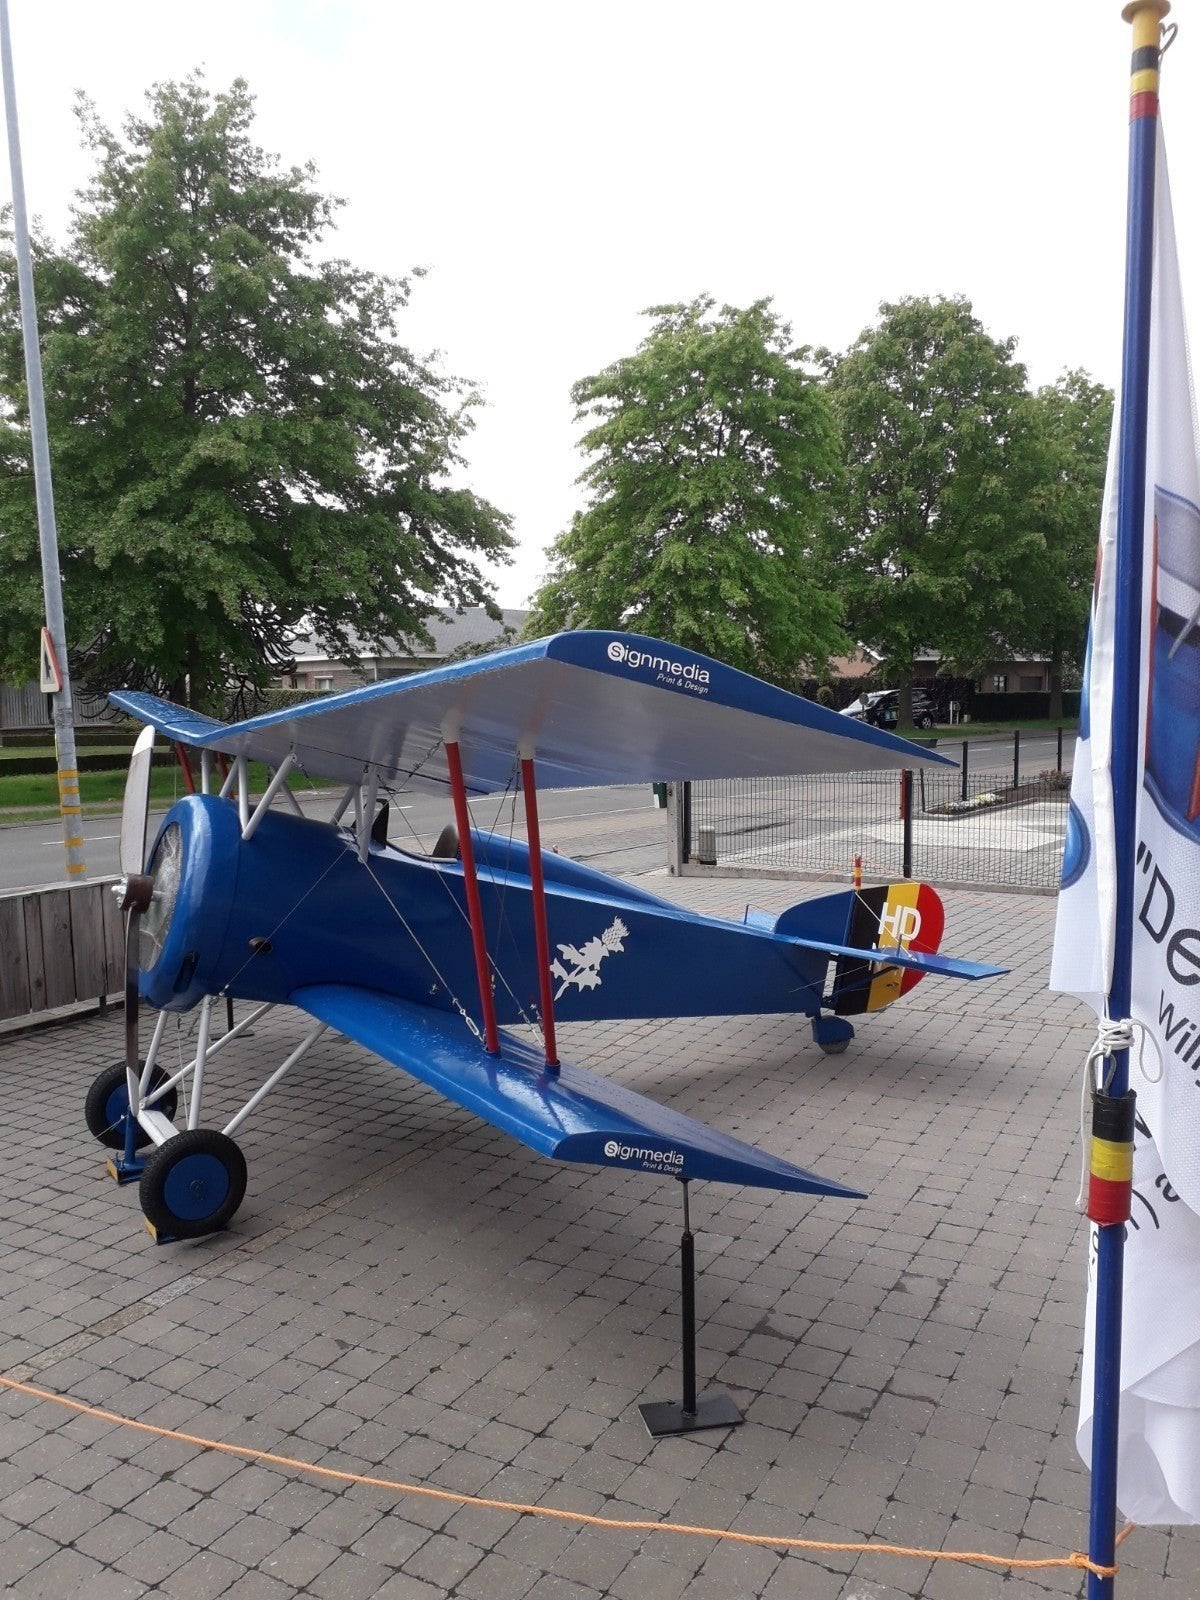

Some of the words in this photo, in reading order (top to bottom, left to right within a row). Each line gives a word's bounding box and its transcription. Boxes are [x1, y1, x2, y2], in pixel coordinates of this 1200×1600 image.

[607, 641, 710, 684] Signmedia
[656, 673, 676, 686] Print
[677, 679, 683, 687] &
[684, 681, 709, 694] Design
[878, 901, 922, 941] HD
[604, 1140, 684, 1165] Signmedia
[642, 1161, 657, 1169] Print
[663, 1164, 683, 1174] Design
